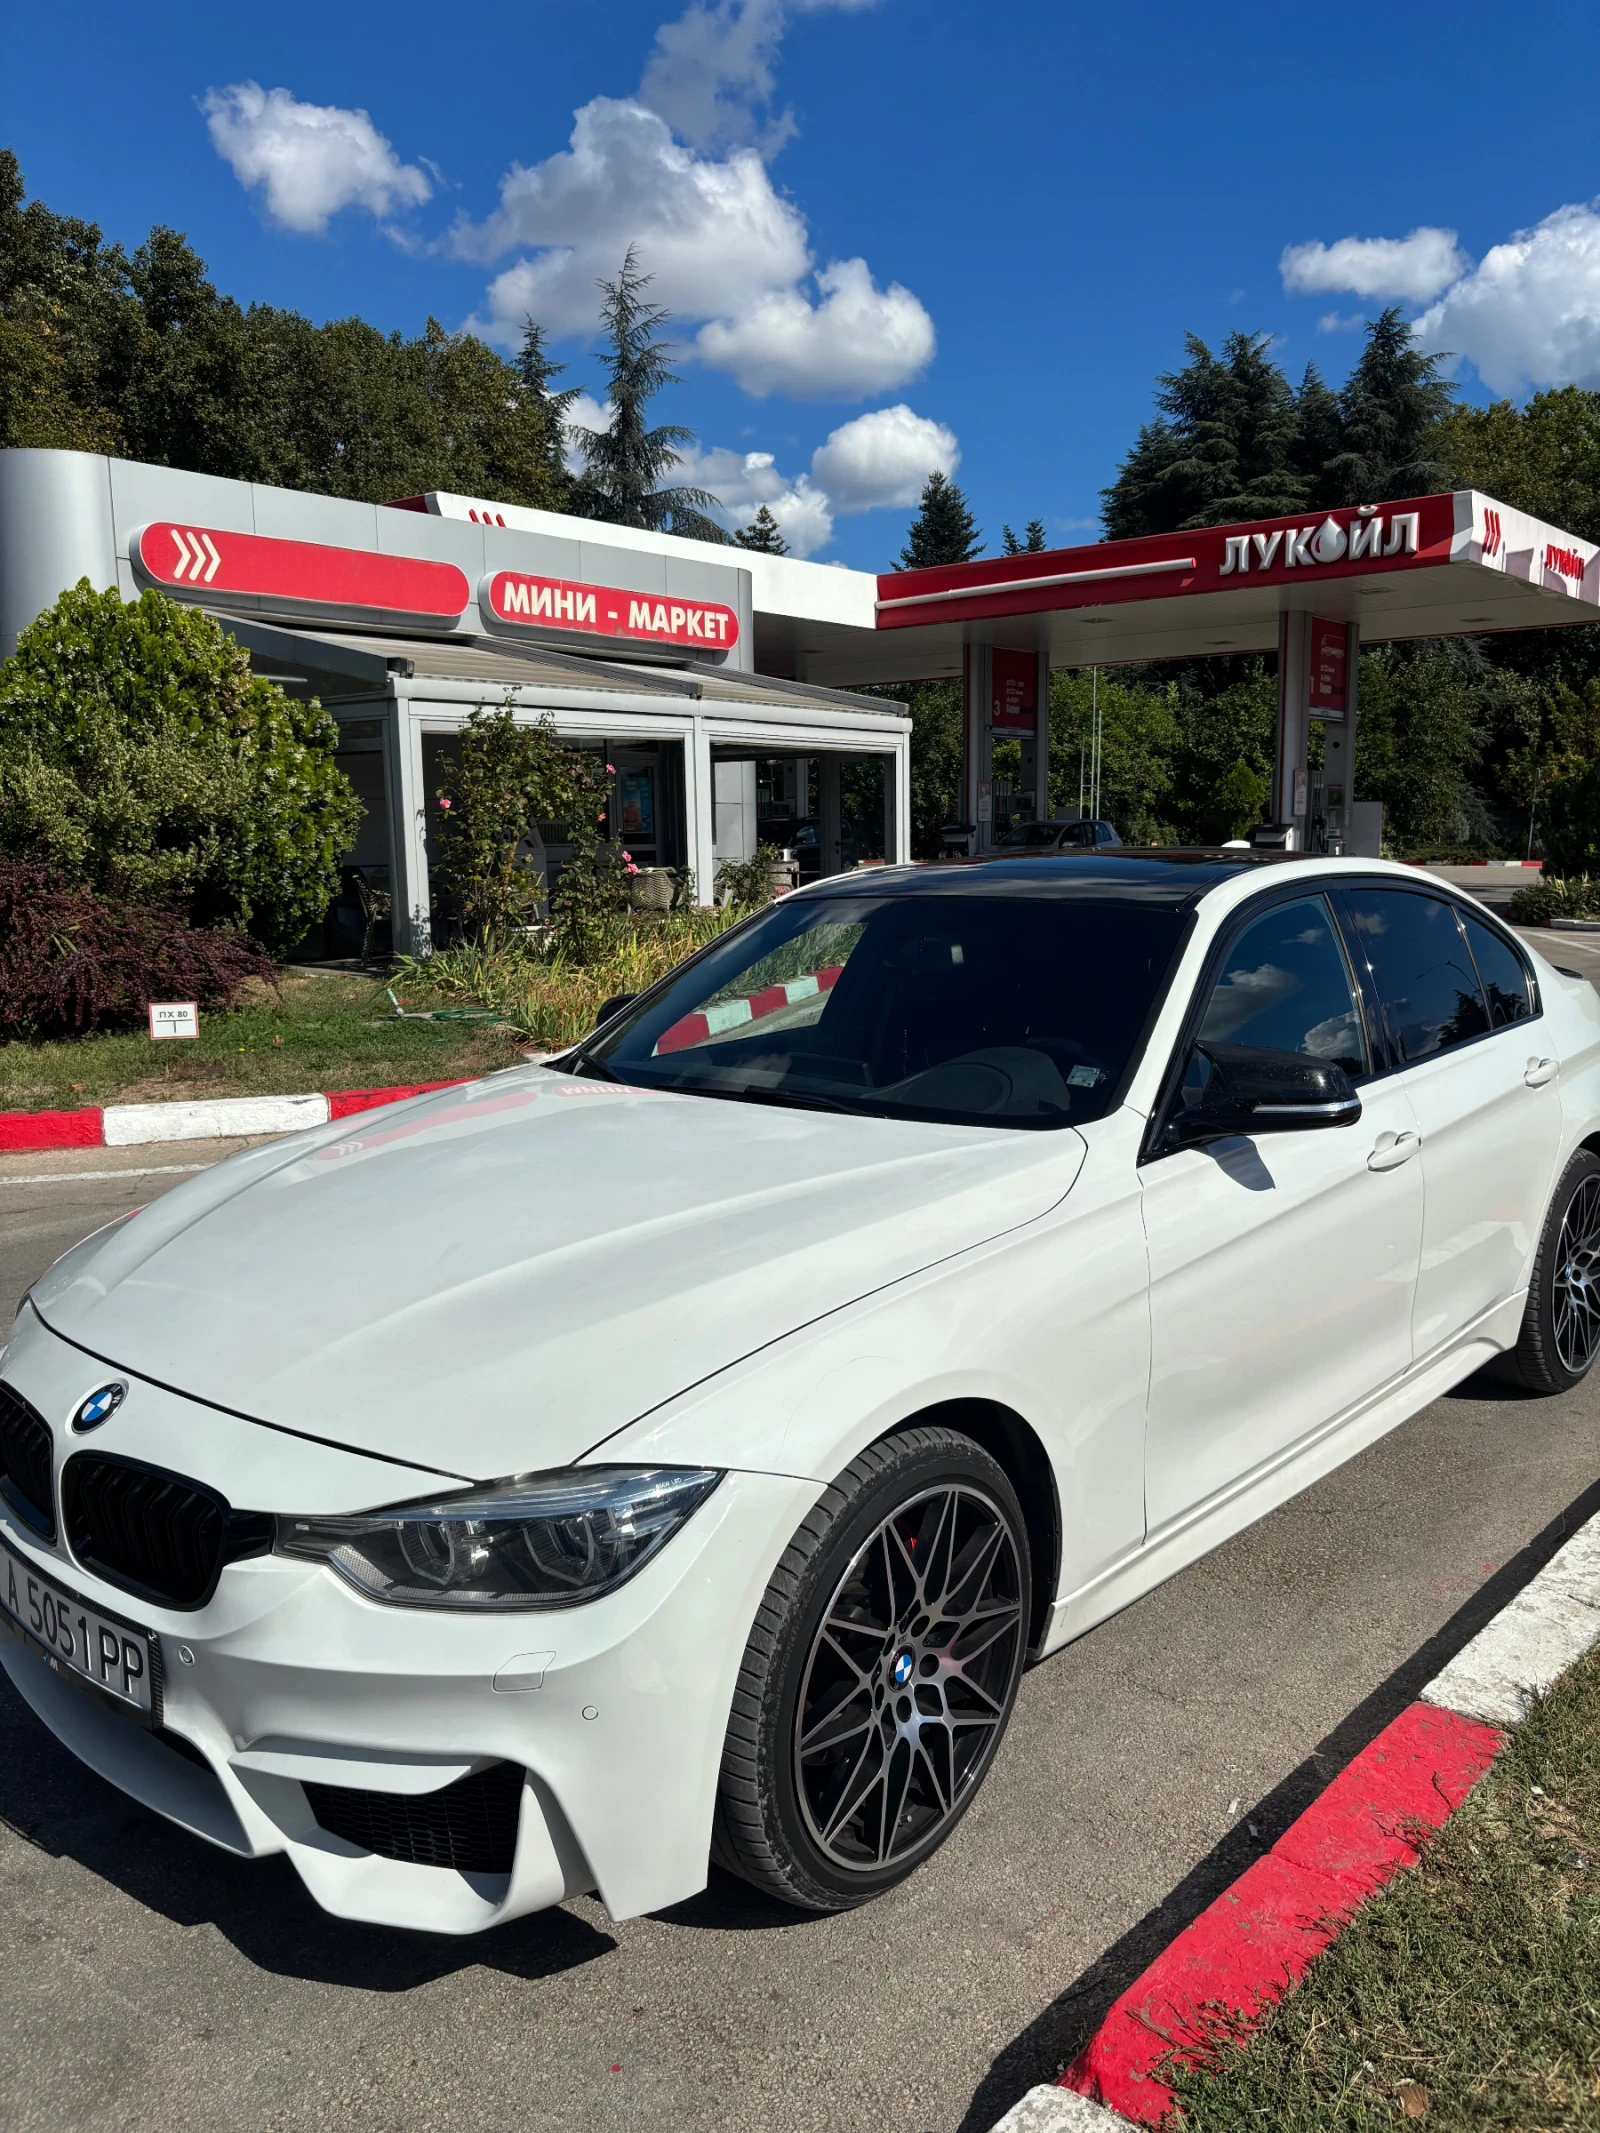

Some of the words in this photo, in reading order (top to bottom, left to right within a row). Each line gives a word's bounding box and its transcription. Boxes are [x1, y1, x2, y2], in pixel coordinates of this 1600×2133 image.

[503, 581, 597, 624] МИНИ
[628, 600, 729, 640] МАРКЕТ
[994, 700, 1000, 716] 3
[8, 1559, 20, 1614] A
